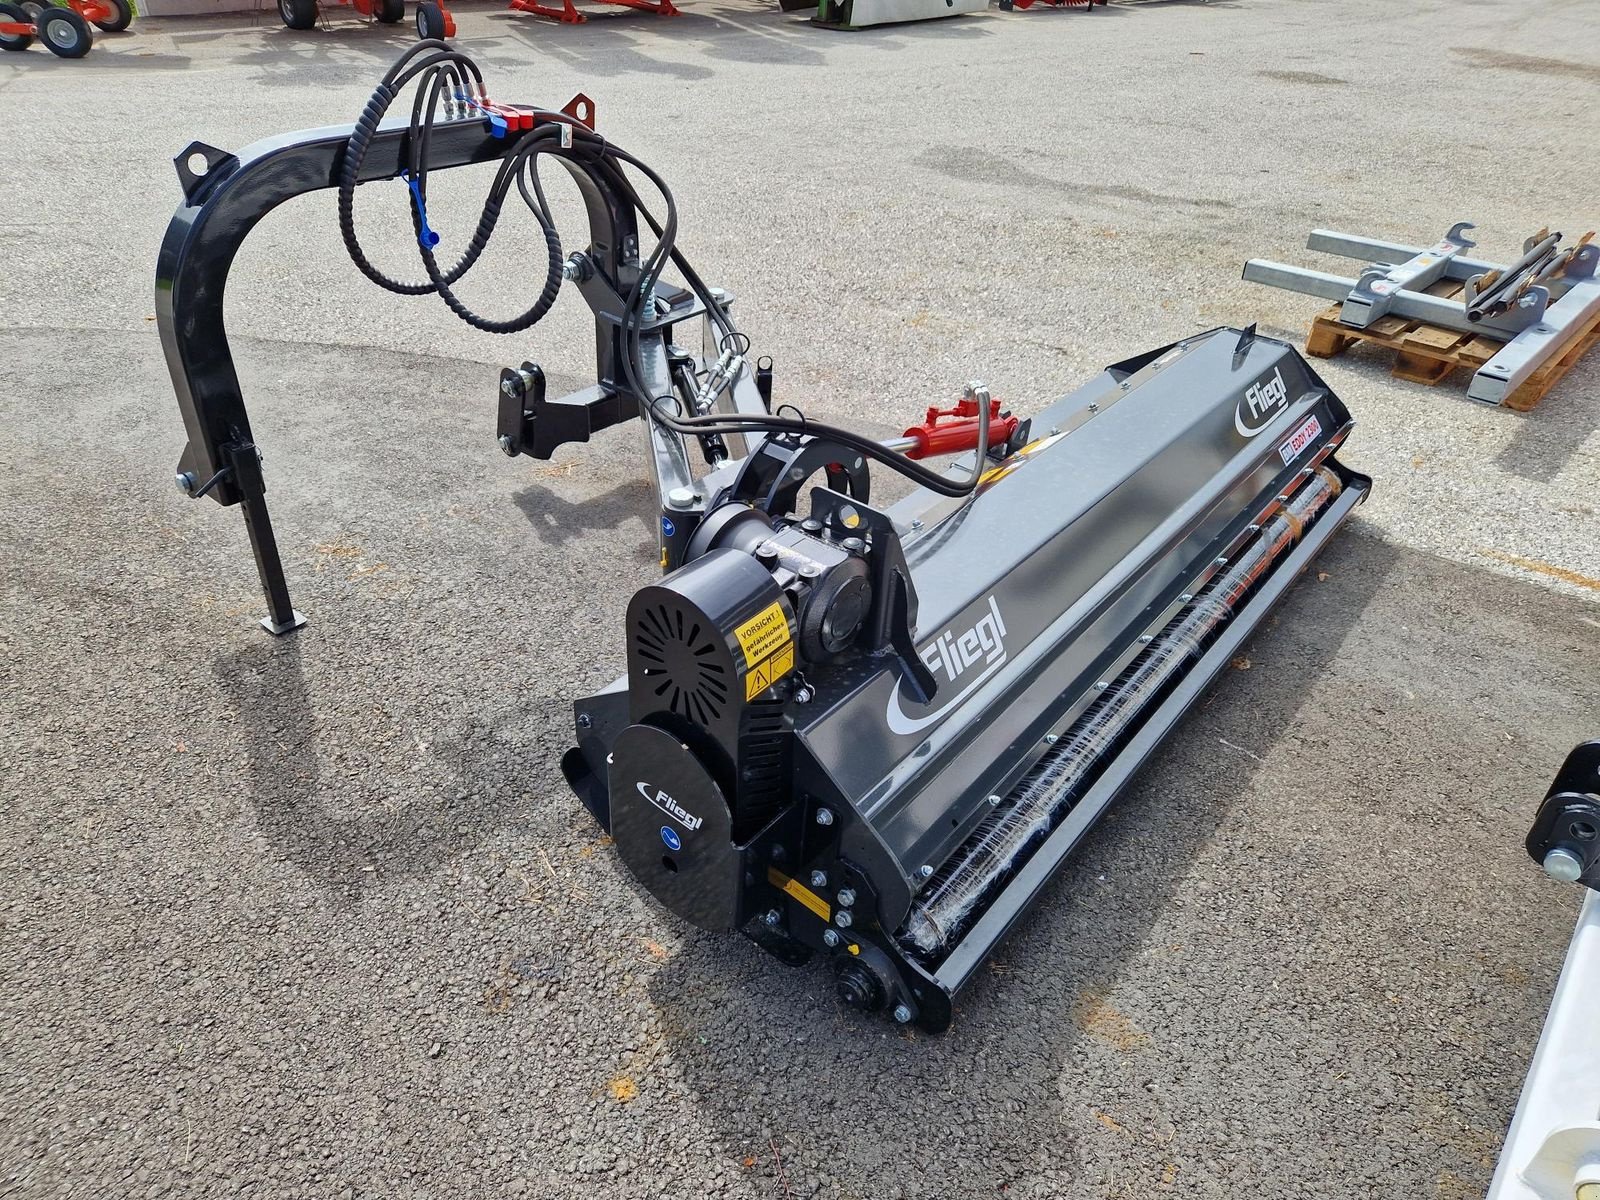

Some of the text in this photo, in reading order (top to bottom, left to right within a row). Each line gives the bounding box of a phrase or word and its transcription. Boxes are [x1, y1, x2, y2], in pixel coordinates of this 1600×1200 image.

[1245, 366, 1287, 420] Fliegl
[1291, 430, 1307, 451] EDDY
[741, 613, 775, 639] VORSICHT
[746, 621, 785, 653] gefährliches
[752, 633, 783, 657] Werkzeug
[655, 790, 703, 830] Fliegl
